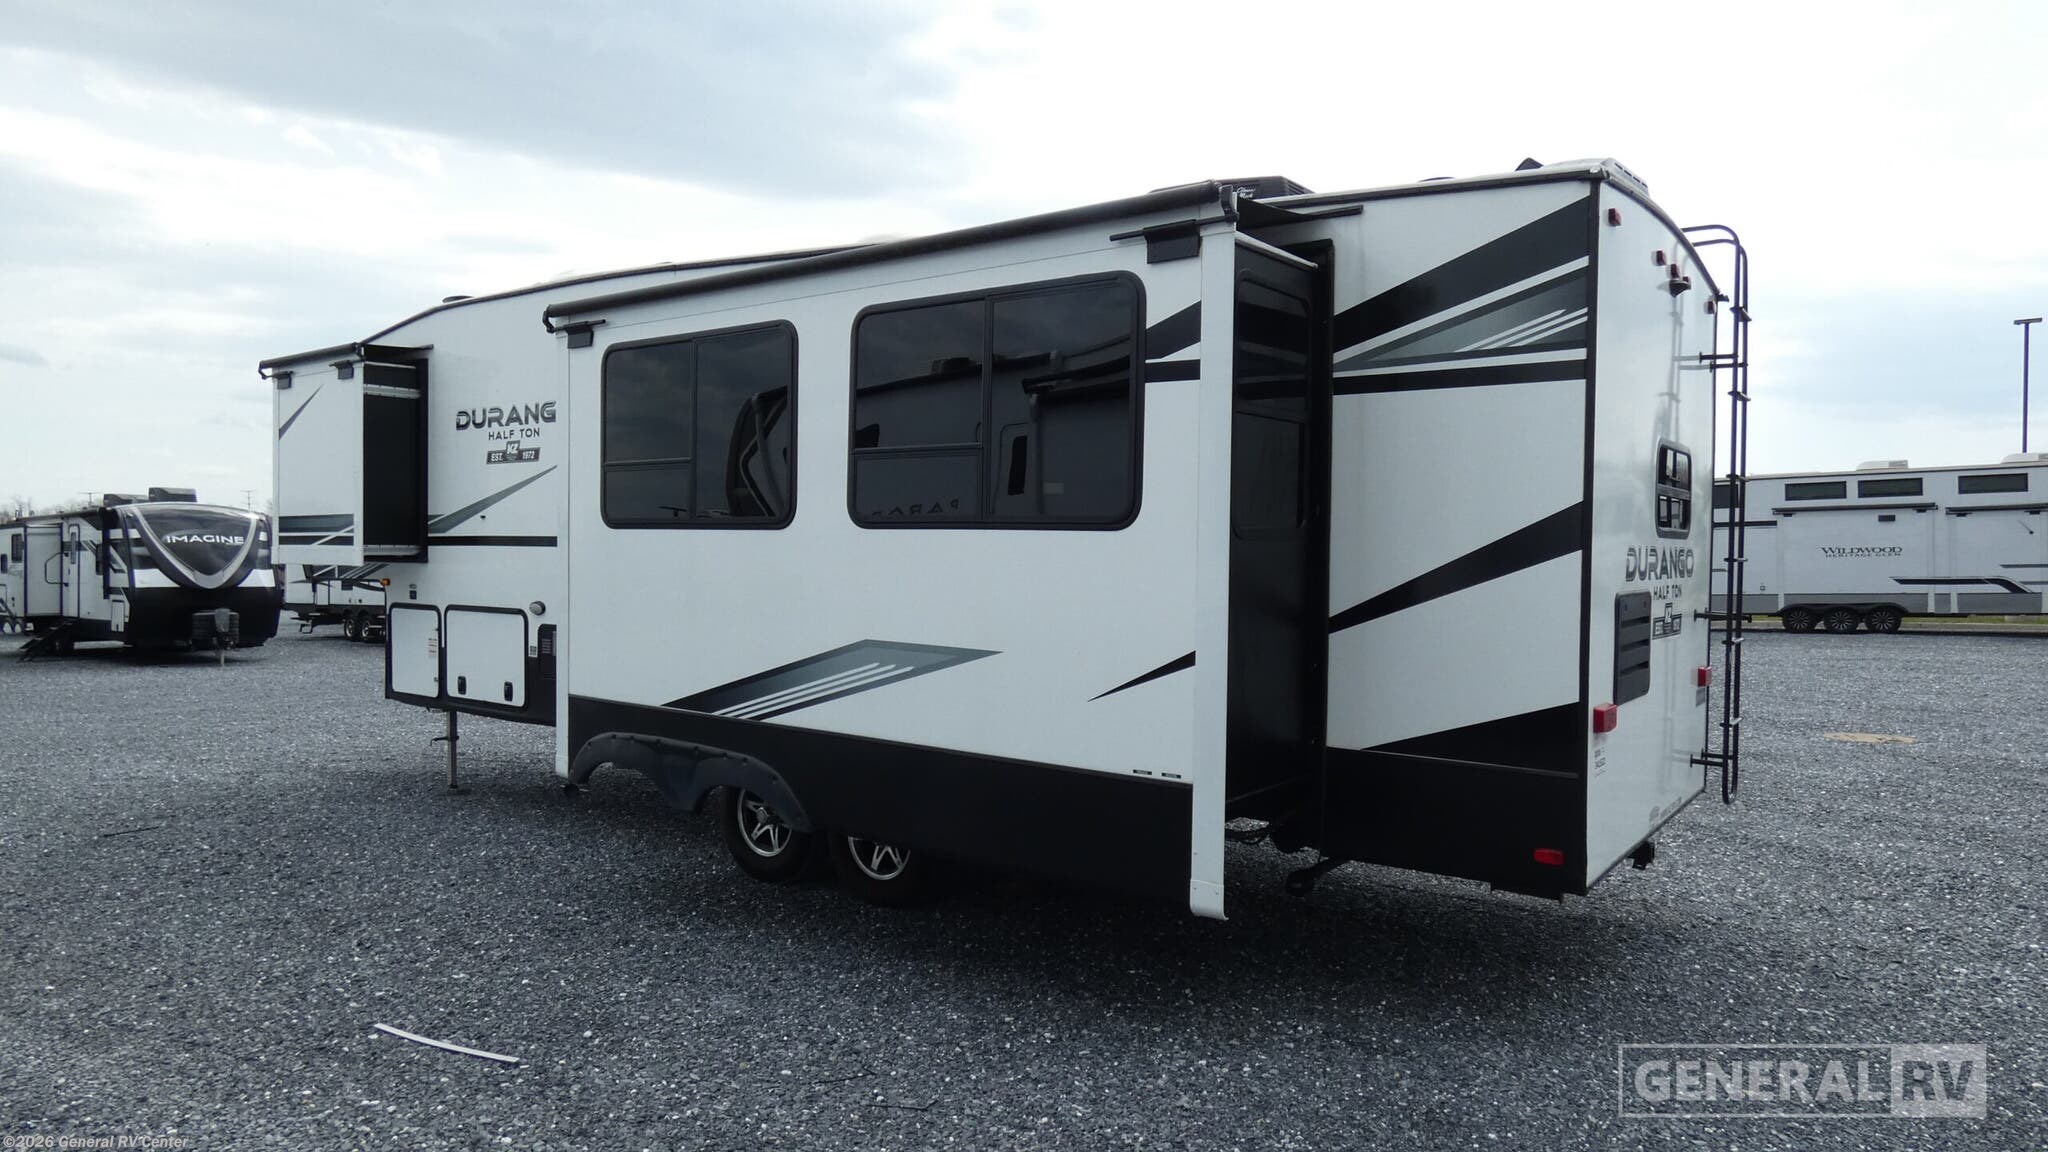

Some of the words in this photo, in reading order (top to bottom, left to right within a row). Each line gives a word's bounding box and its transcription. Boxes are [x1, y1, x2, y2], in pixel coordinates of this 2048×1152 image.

[456, 401, 557, 430] DURANG
[488, 429, 515, 440] HALF
[520, 428, 540, 438] TON
[166, 534, 244, 544] IMAGINE
[1820, 546, 1903, 555] WILDWOOD
[1625, 546, 1695, 582] DURANGO
[1653, 585, 1670, 600] HALF
[1671, 584, 1683, 599] TON
